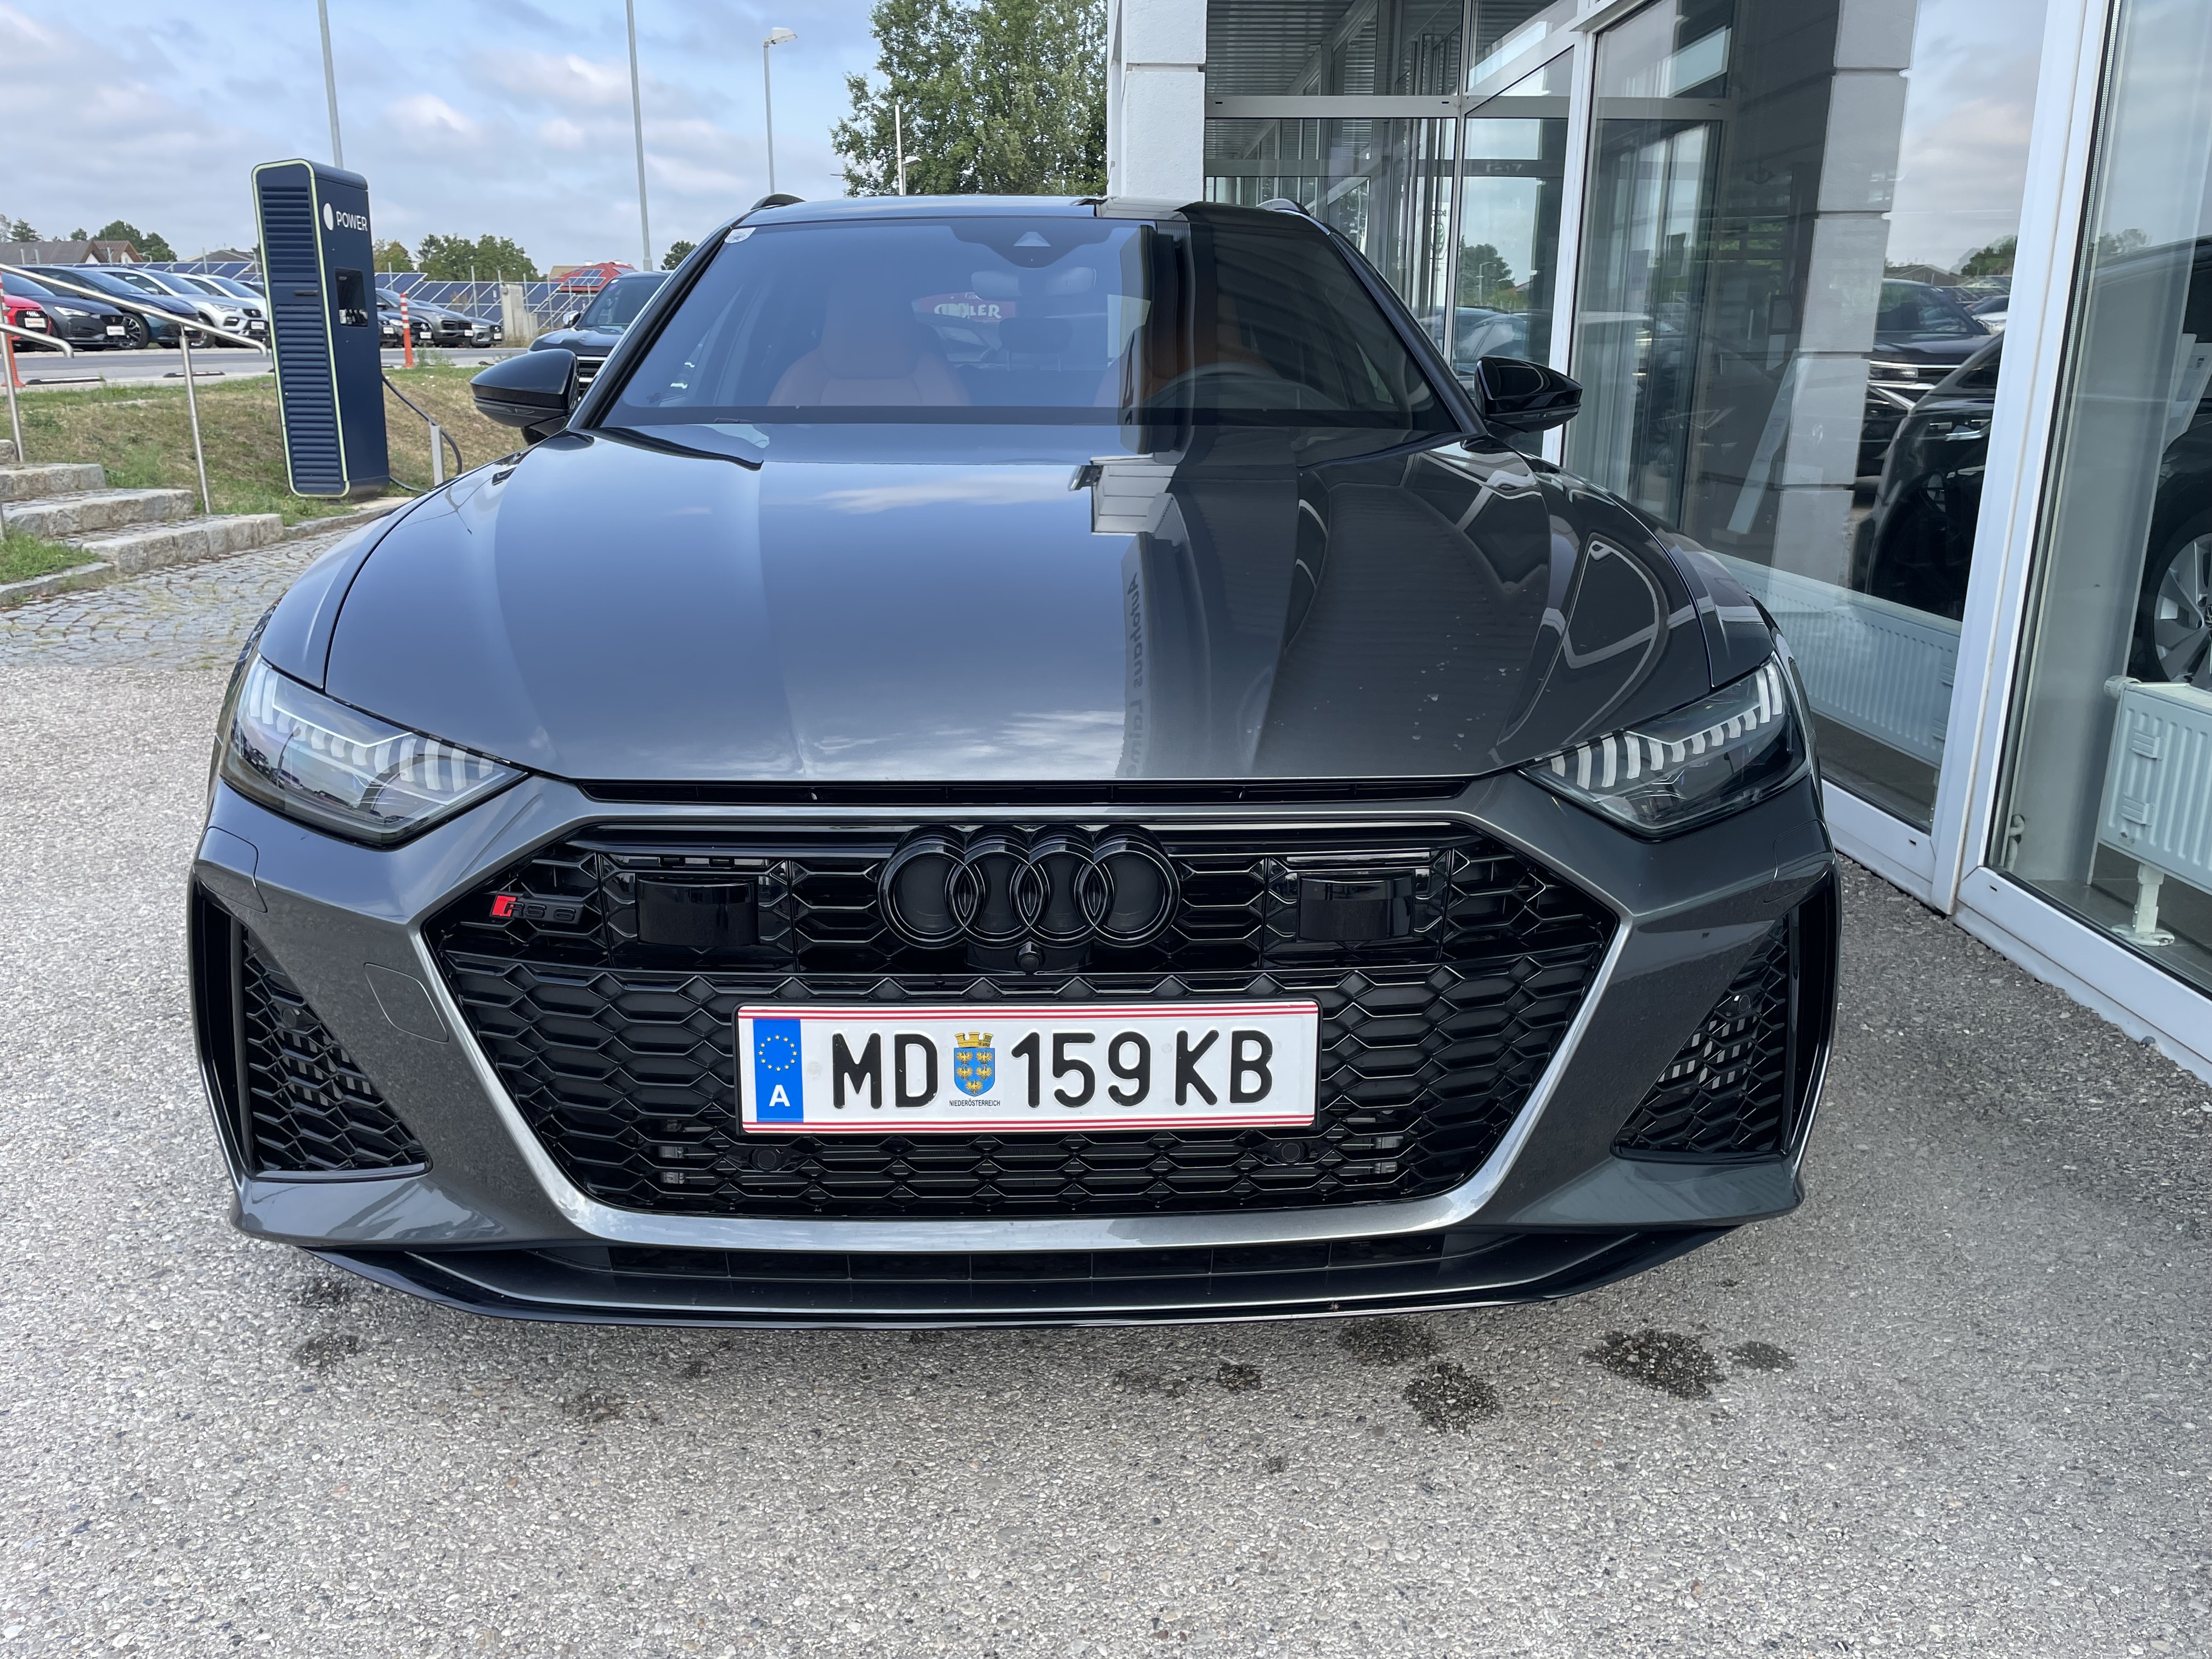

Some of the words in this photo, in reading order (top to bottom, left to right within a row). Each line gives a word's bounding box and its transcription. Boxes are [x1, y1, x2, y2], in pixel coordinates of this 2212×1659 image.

[336, 211, 368, 232] POWER
[500, 899, 547, 919] RS
[553, 907, 577, 922] 6
[832, 1033, 938, 1109] MD
[1011, 1031, 1152, 1108] 159
[1175, 1030, 1273, 1106] KB
[769, 1085, 791, 1107] A
[949, 1099, 1001, 1107] NIEDERÖSTERREICH
